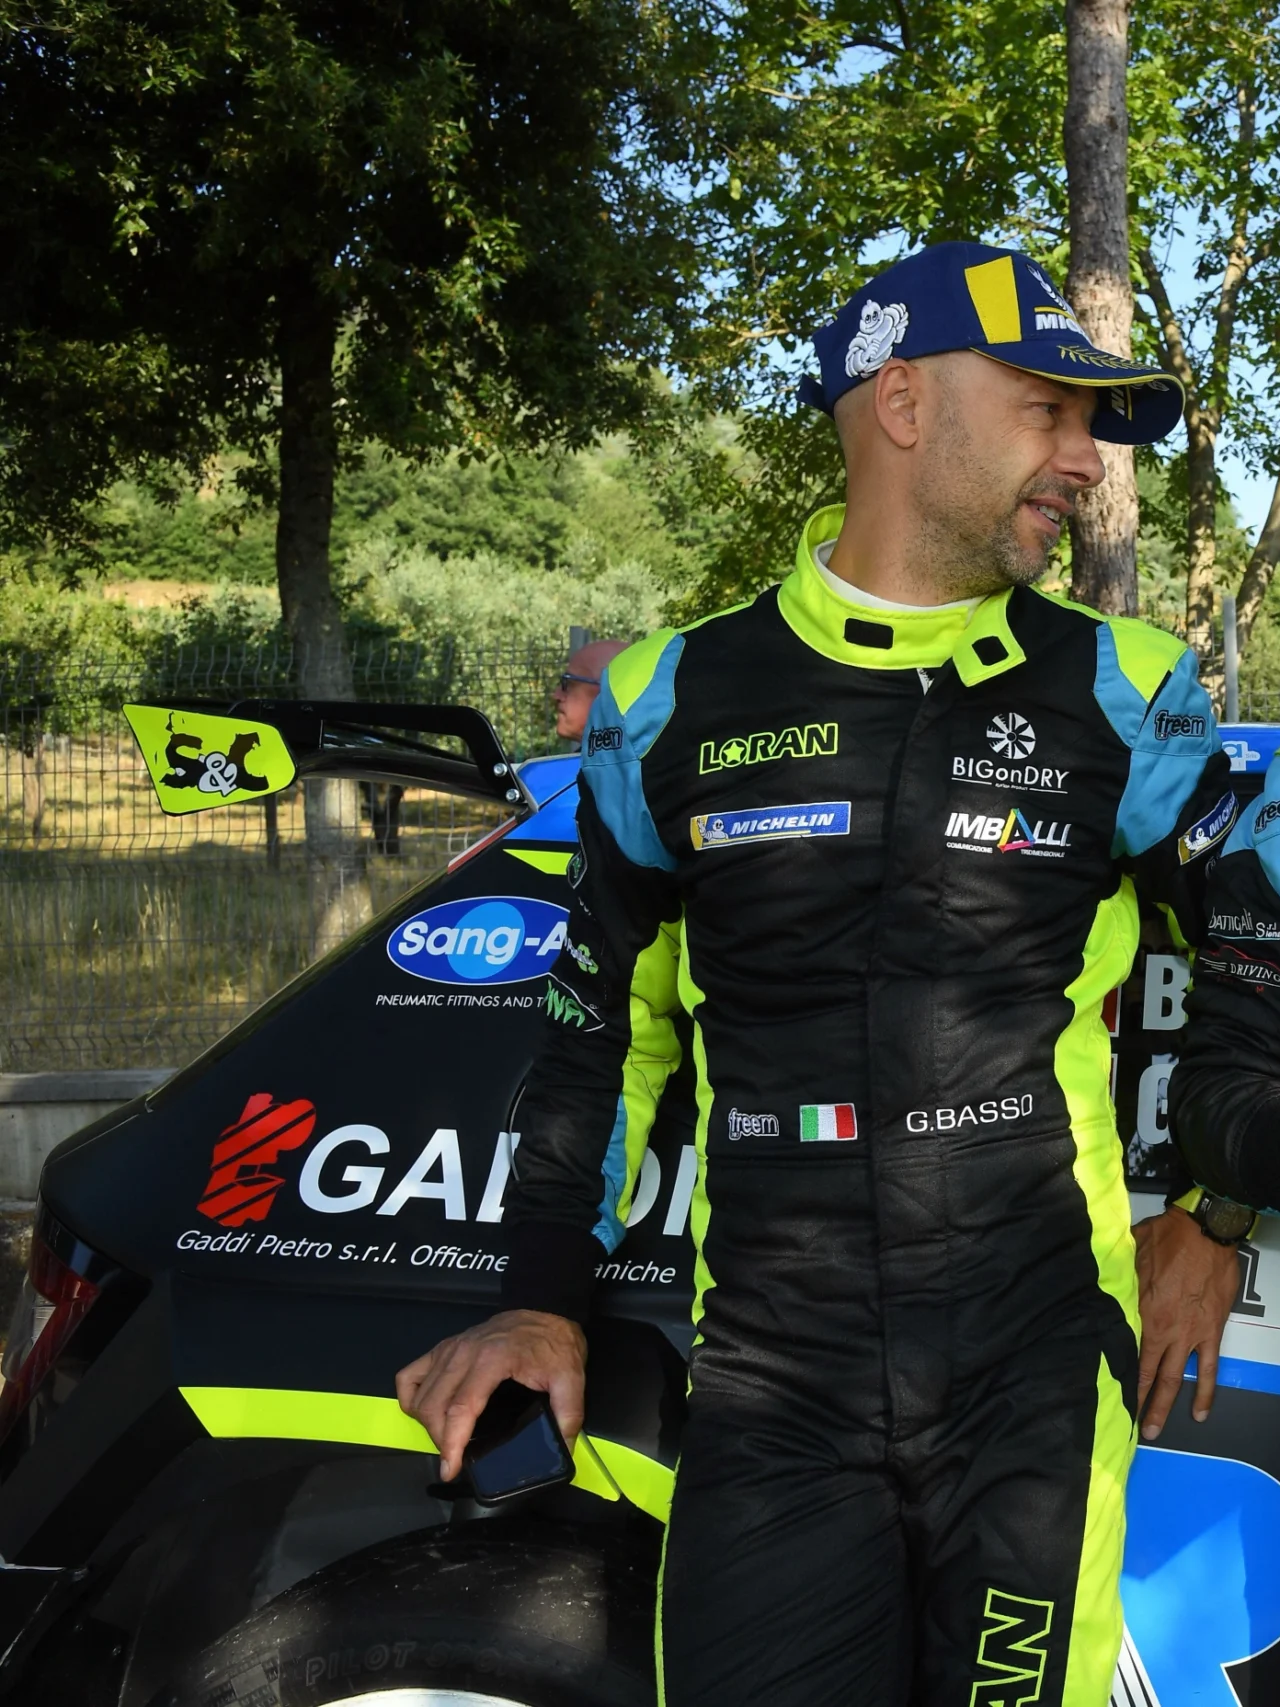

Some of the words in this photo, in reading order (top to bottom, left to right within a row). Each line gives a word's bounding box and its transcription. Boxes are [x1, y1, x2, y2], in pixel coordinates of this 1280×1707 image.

[1155, 710, 1205, 739] freem
[699, 723, 838, 775] LORAN
[953, 757, 1070, 788] BIGonDRY
[730, 812, 835, 836] MICHELIN
[376, 994, 445, 1006] PNEUMATIC
[447, 995, 500, 1007] FITTINGS
[503, 997, 534, 1008] AND
[729, 1108, 779, 1140] freem
[906, 1094, 1033, 1133] G.BASSO
[176, 1230, 255, 1255] Gaddi
[256, 1234, 333, 1260] Pietro
[338, 1241, 398, 1265] s.r.l.
[410, 1243, 510, 1274] Officine
